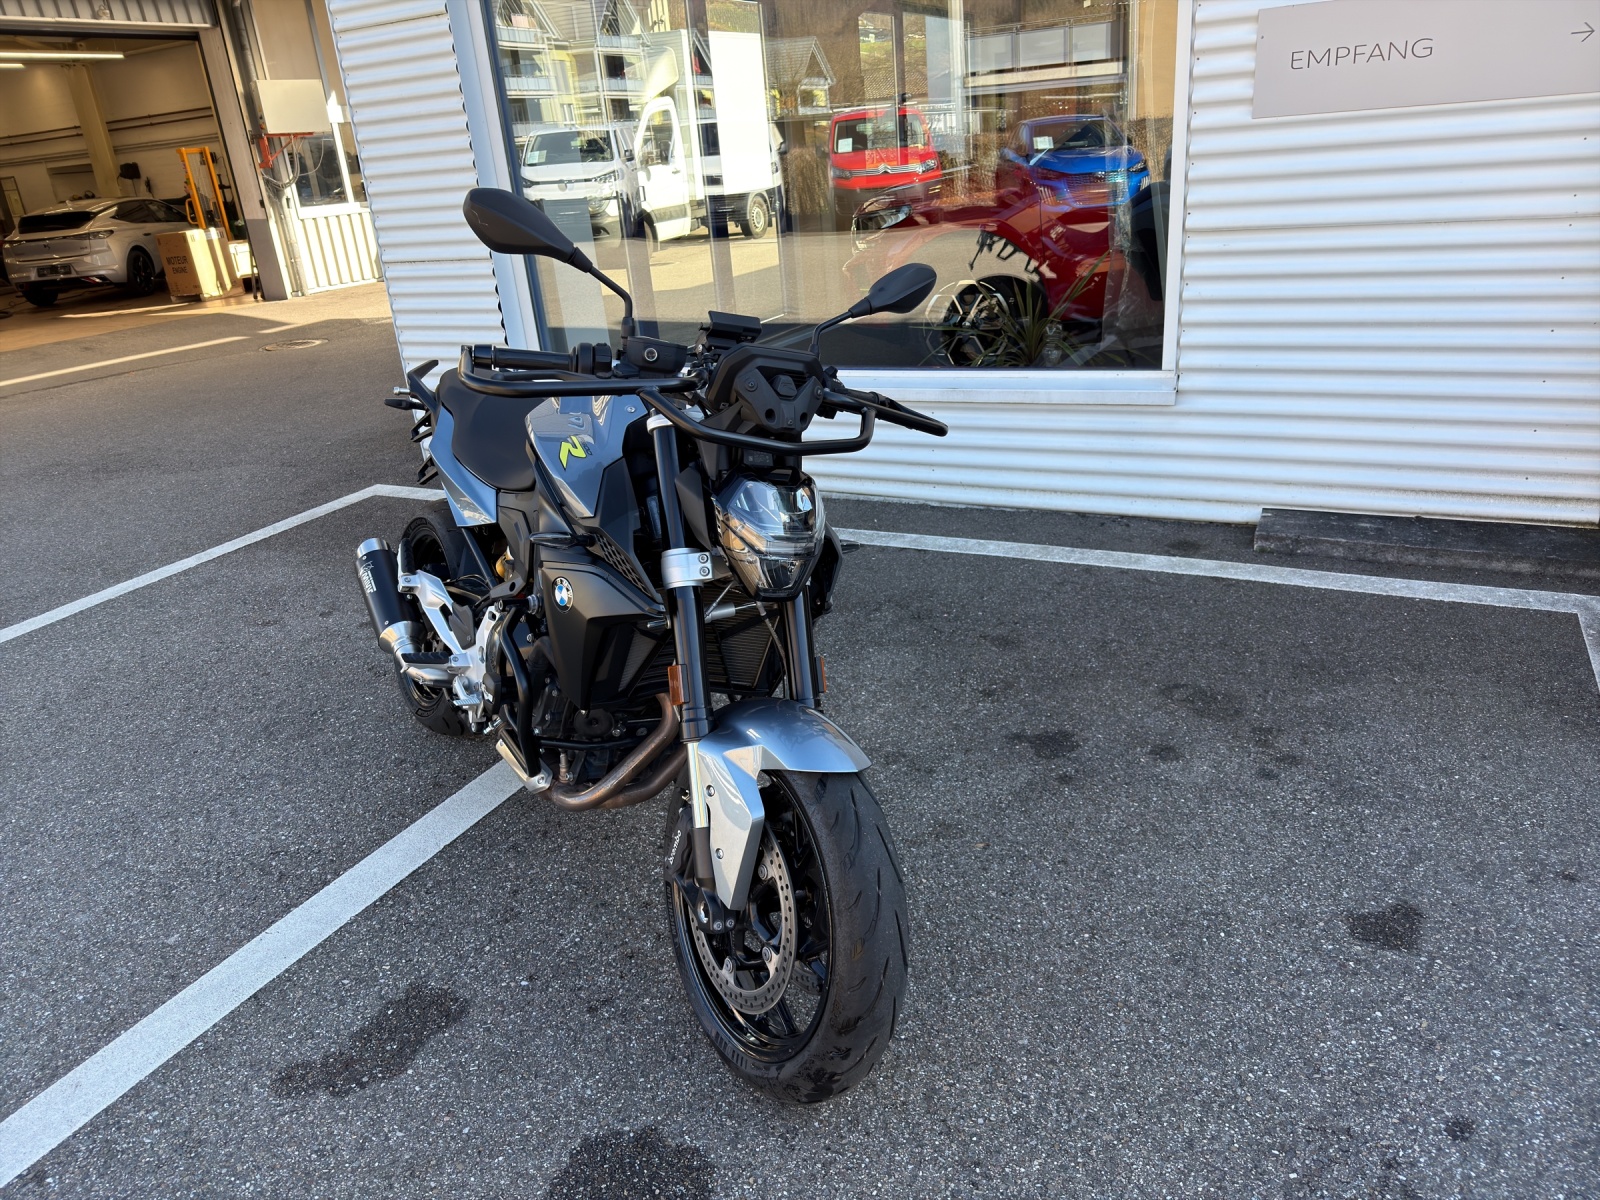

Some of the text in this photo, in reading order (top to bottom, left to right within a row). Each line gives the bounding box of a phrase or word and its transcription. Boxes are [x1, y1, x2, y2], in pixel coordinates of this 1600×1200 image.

[1291, 38, 1433, 70] EMPFANG
[166, 255, 188, 265] MOTEUR
[172, 266, 188, 274] ENGINE
[668, 829, 682, 865] brembo
[665, 884, 678, 935] MICHELIN
